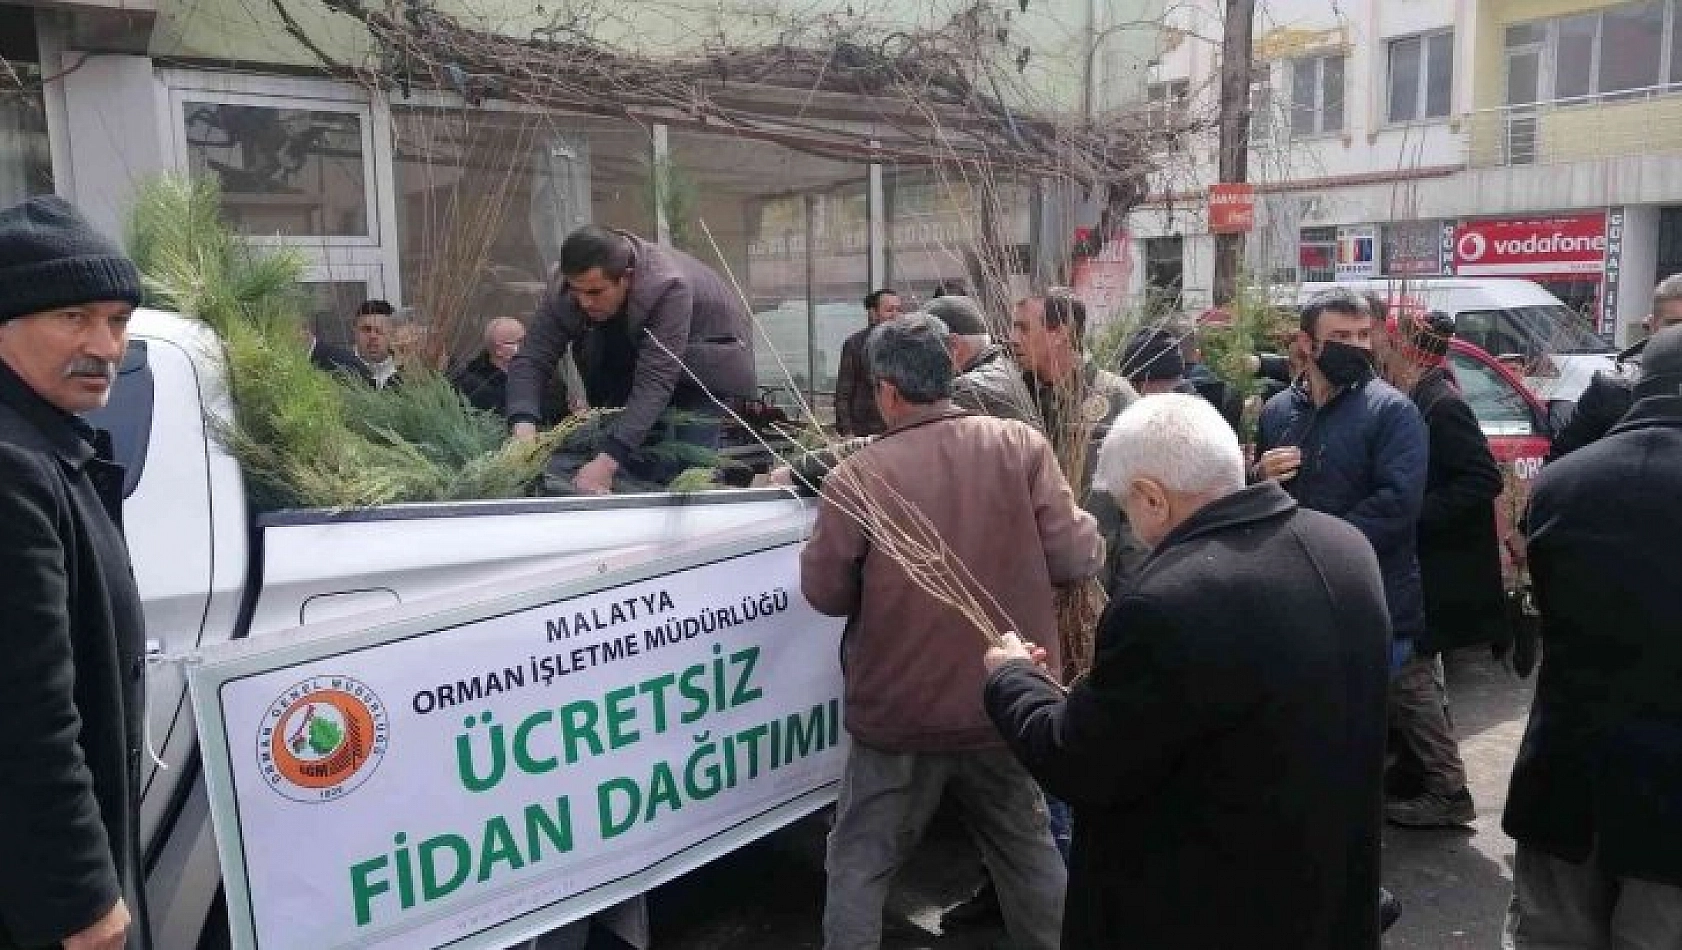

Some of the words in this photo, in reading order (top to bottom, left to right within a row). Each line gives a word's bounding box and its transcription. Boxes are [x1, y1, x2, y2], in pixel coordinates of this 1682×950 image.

[1494, 231, 1606, 256] vodafone
[412, 665, 525, 715] ORMAN
[529, 632, 639, 687] İŞLETME
[643, 586, 788, 652] MÜDÜRLÜĞÜ
[546, 589, 675, 643] MALATYA
[456, 642, 764, 792] ÜCRETSİZ
[349, 795, 574, 927] FİDAN
[597, 698, 839, 839] DAĞITIMI
